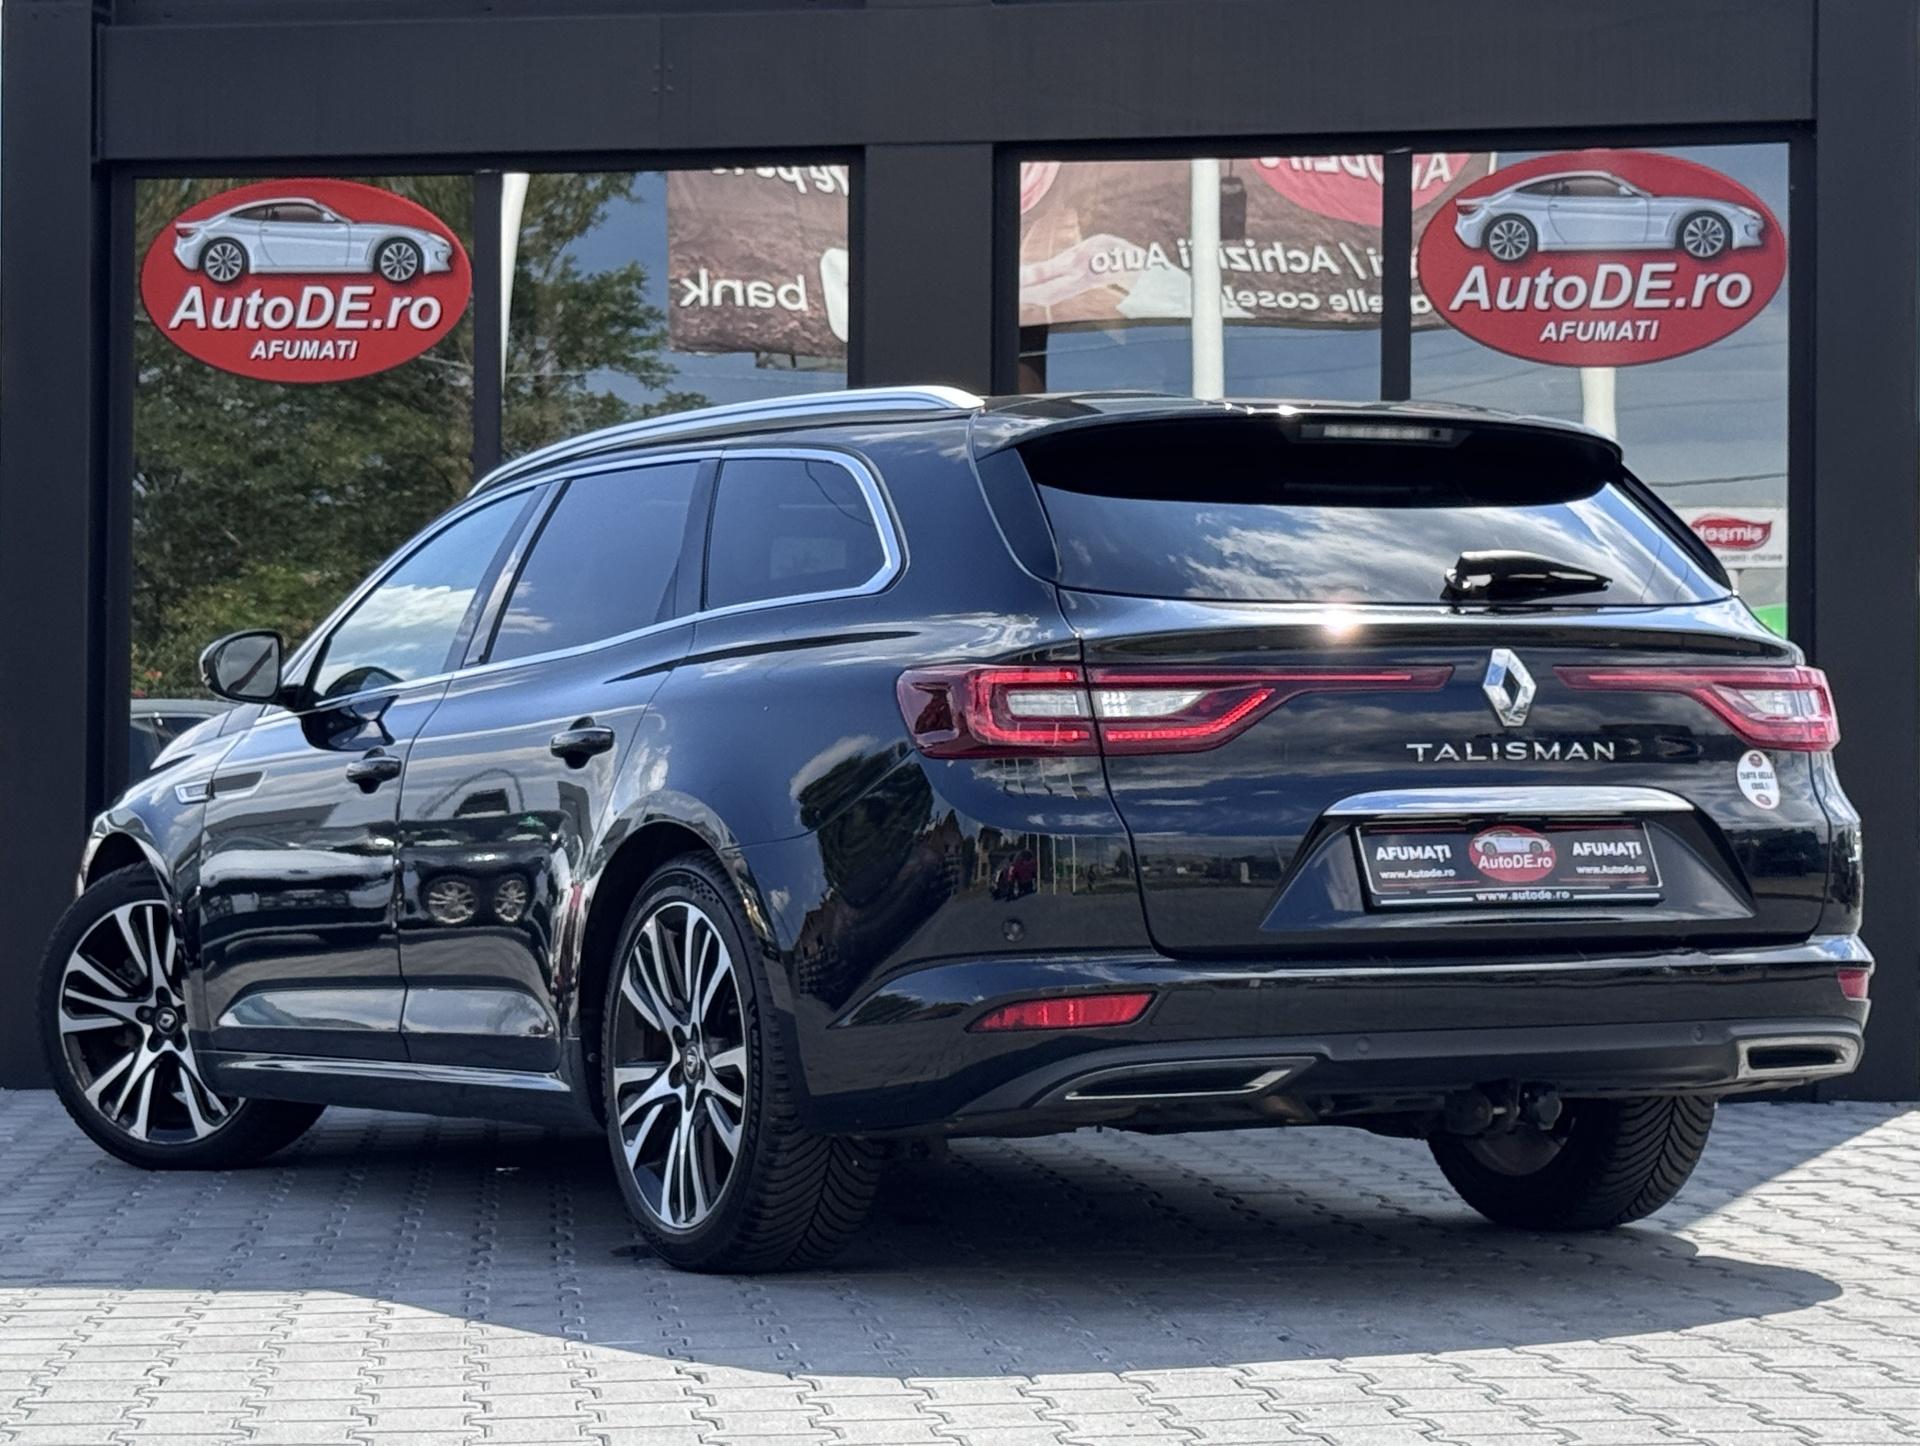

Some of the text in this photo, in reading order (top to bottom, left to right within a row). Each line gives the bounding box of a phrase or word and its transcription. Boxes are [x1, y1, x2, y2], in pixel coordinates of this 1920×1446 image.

[1449, 262, 1753, 312] AutoDE.ro
[169, 285, 442, 330] AutoDE.ro
[1540, 319, 1660, 343] AFUMATI
[250, 339, 360, 361] AFUMATI
[1406, 740, 1616, 763] TALISMAN
[1478, 854, 1553, 870] AutoDE.ro
[1476, 890, 1571, 901] www.autode.ro
